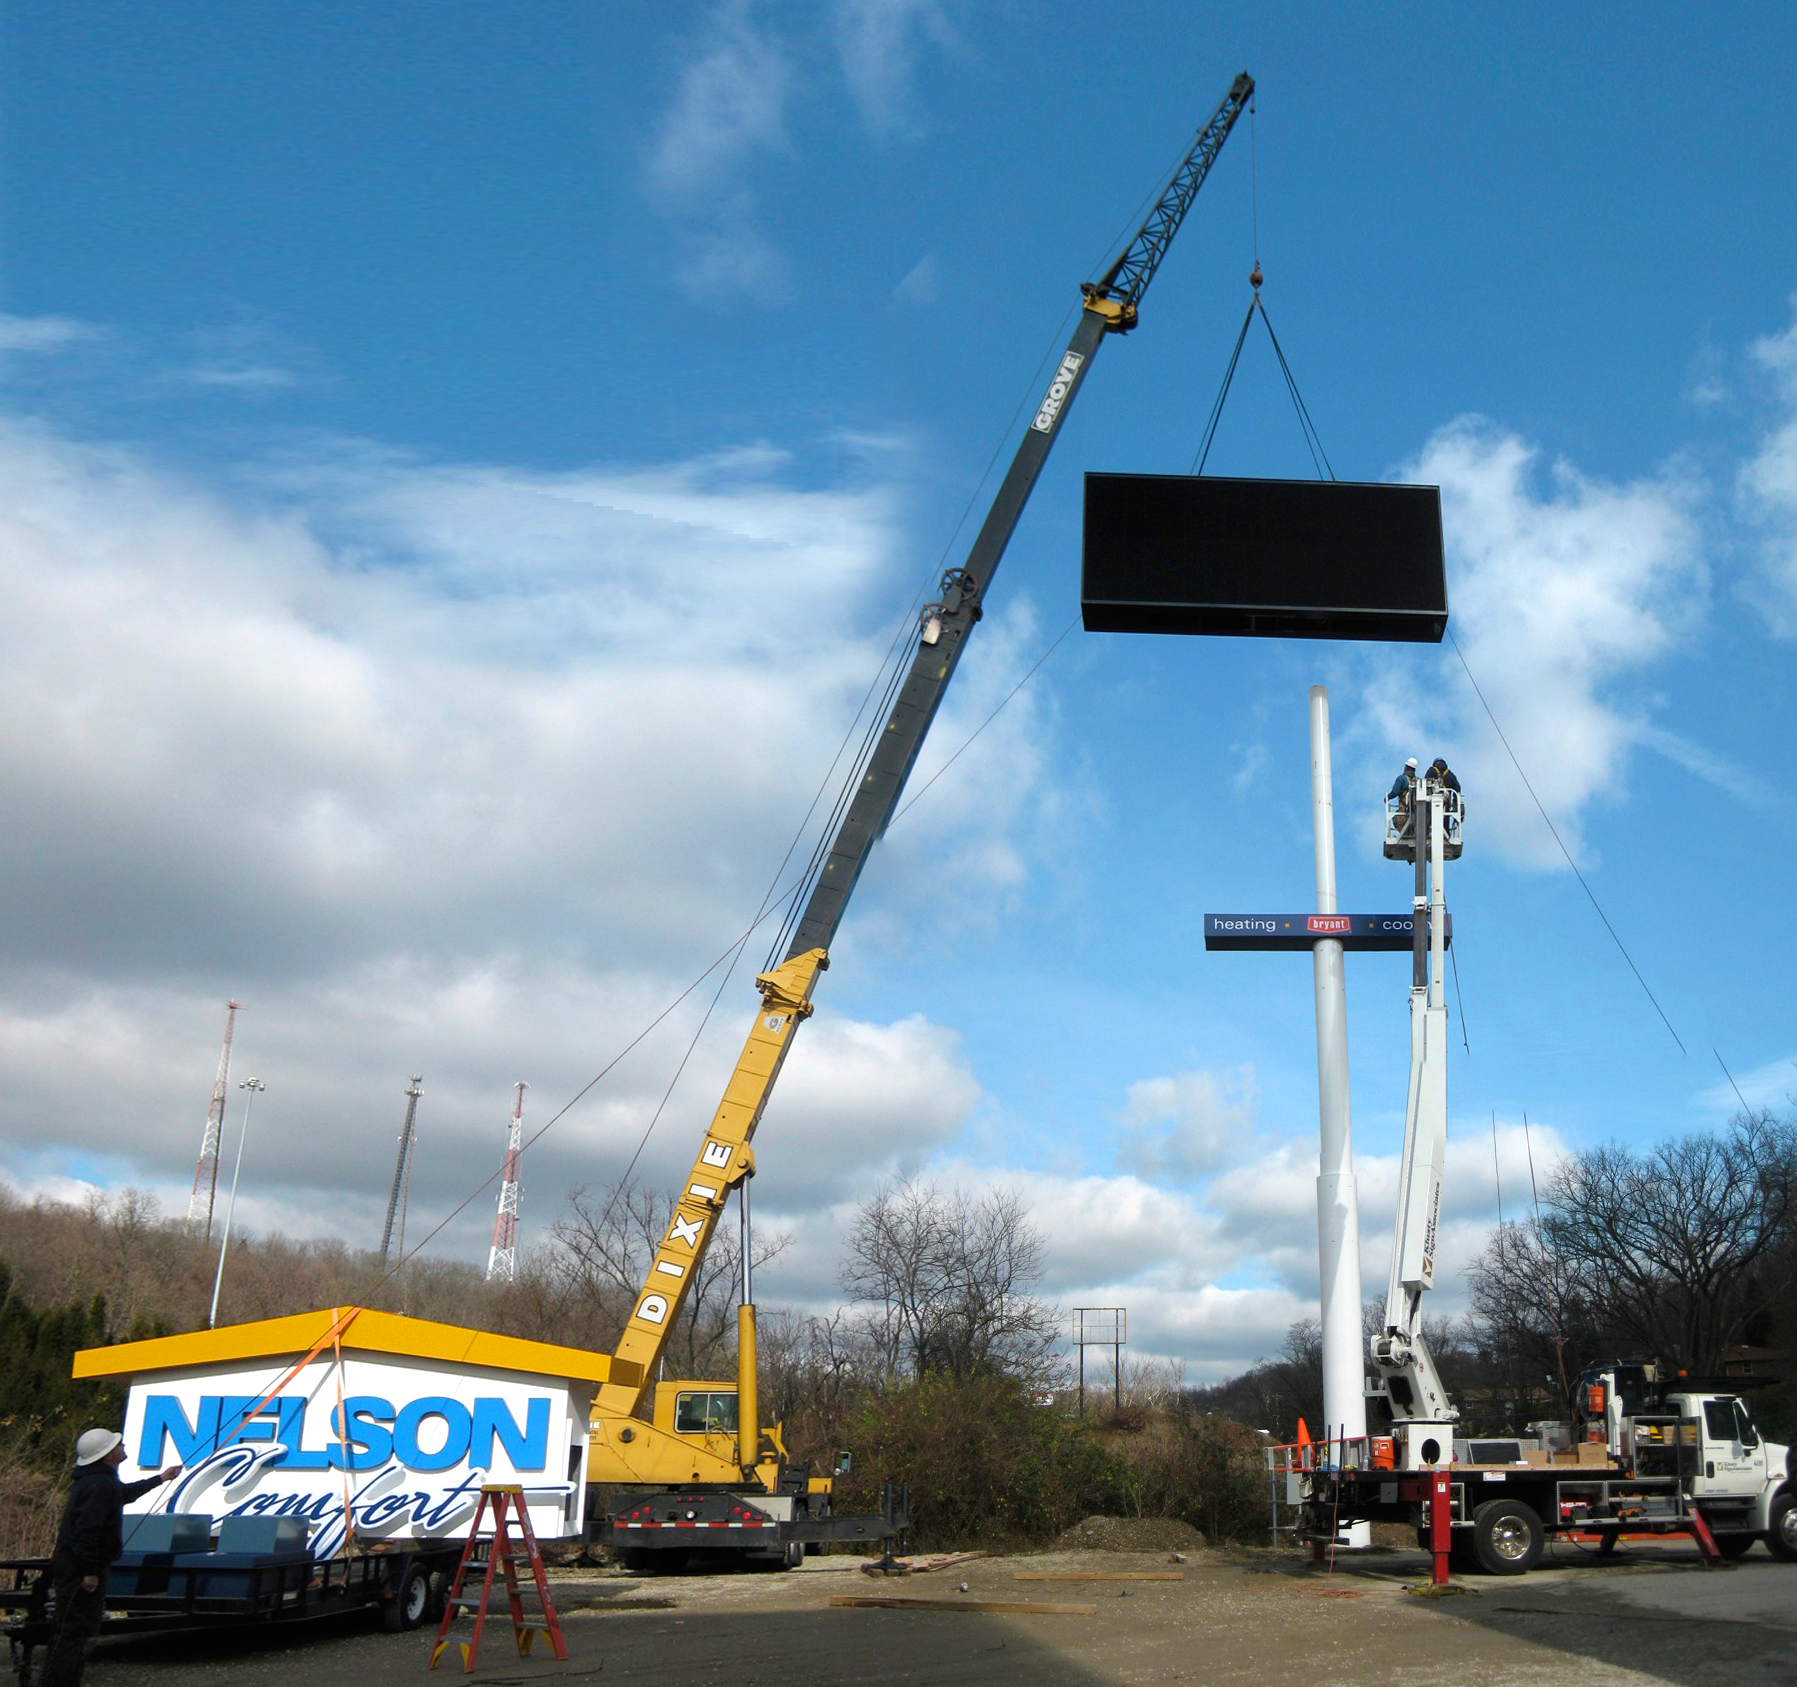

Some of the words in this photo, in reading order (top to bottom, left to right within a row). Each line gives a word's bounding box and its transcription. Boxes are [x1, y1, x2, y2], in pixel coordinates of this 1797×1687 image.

[1035, 355, 1080, 429] GROVE
[1214, 918, 1276, 933] heating
[1313, 919, 1346, 930] bryant
[636, 1141, 734, 1325] DIXIE
[137, 1395, 551, 1470] NELSON
[166, 1443, 577, 1560] Comfort
